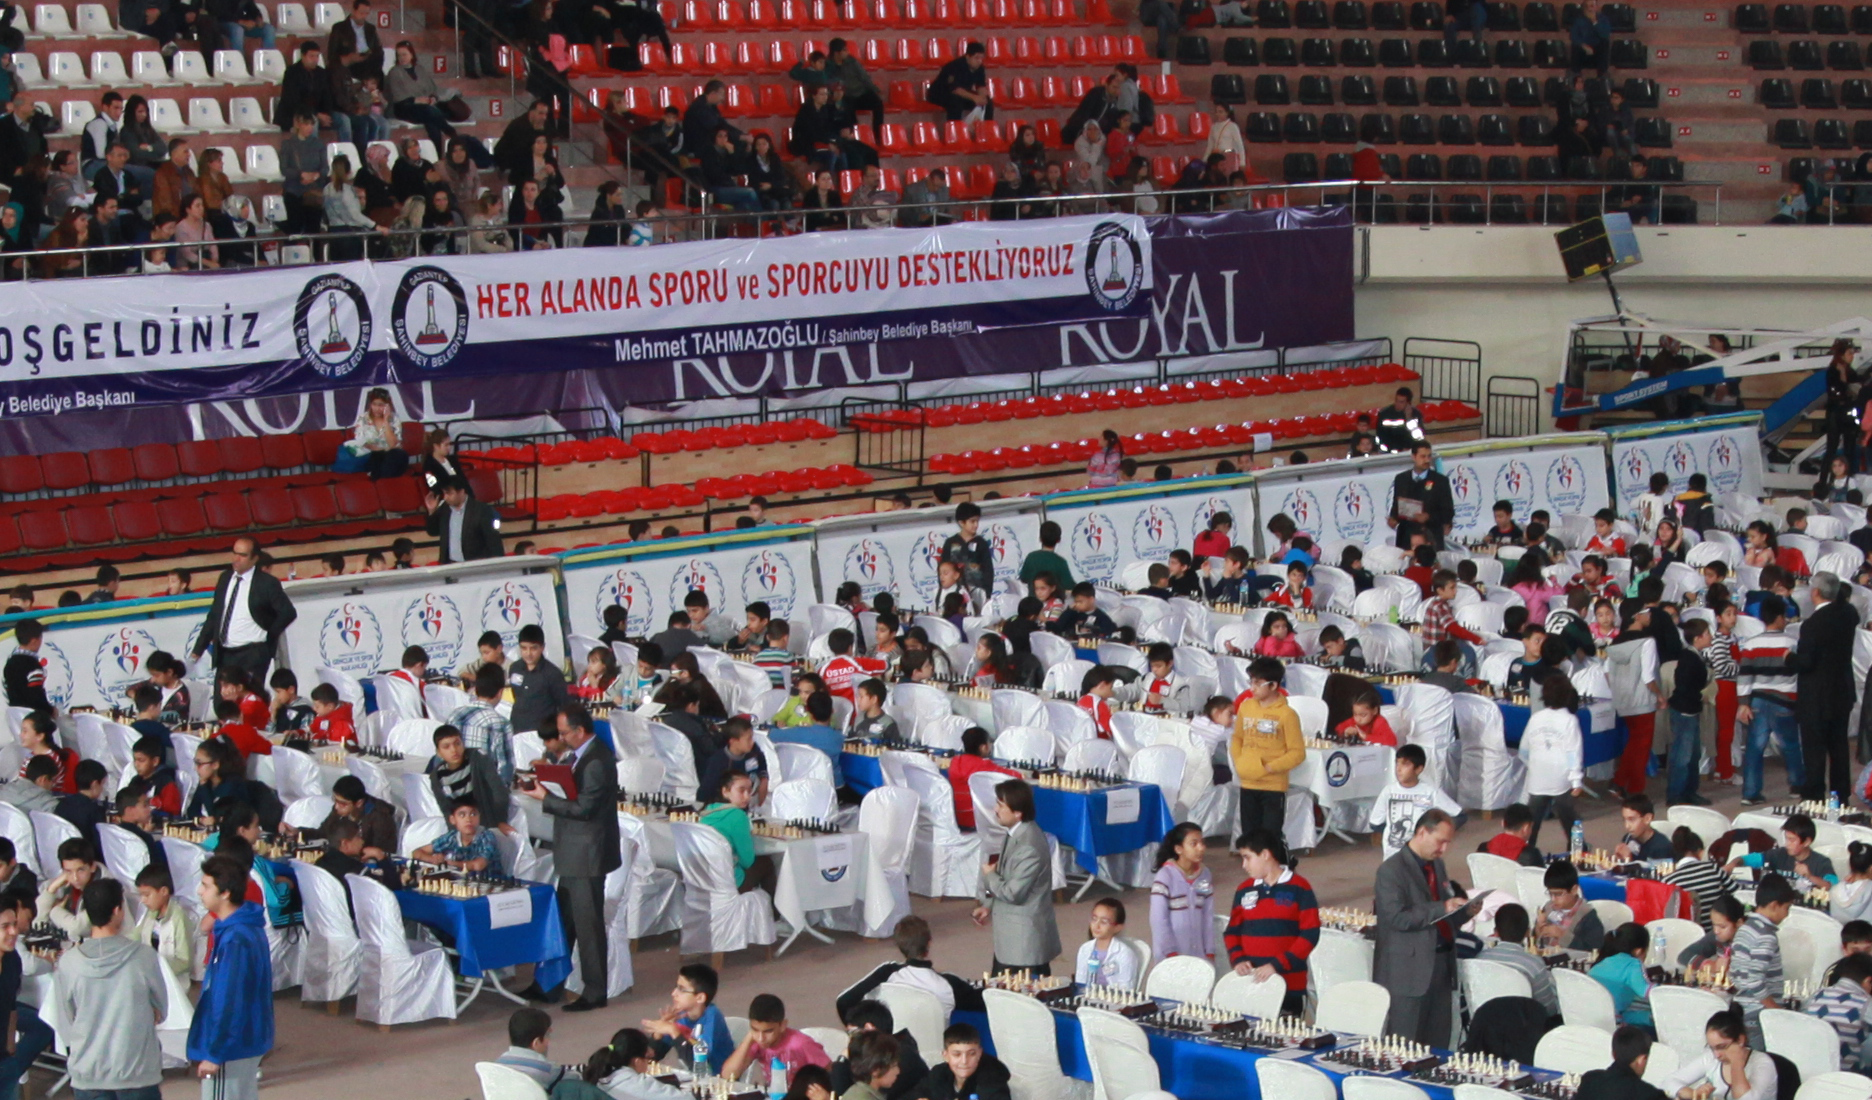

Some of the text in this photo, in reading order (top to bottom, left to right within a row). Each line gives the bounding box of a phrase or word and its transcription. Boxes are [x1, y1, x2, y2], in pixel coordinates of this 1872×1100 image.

[492, 101, 500, 115] E
[477, 240, 1074, 323] HER ALANDA SPORU ve SPORCUYU DESTEKLİYORUZ
[614, 337, 688, 362] Mehmet
[691, 320, 819, 356] TAHMAZOĞLU
[828, 326, 880, 346] Şahinbey
[882, 322, 929, 340] Belediye
[931, 319, 973, 336] Başkanı
[9, 394, 71, 416] Belediye
[76, 390, 135, 410] Başkanı
[826, 666, 855, 678] ÜSTAD
